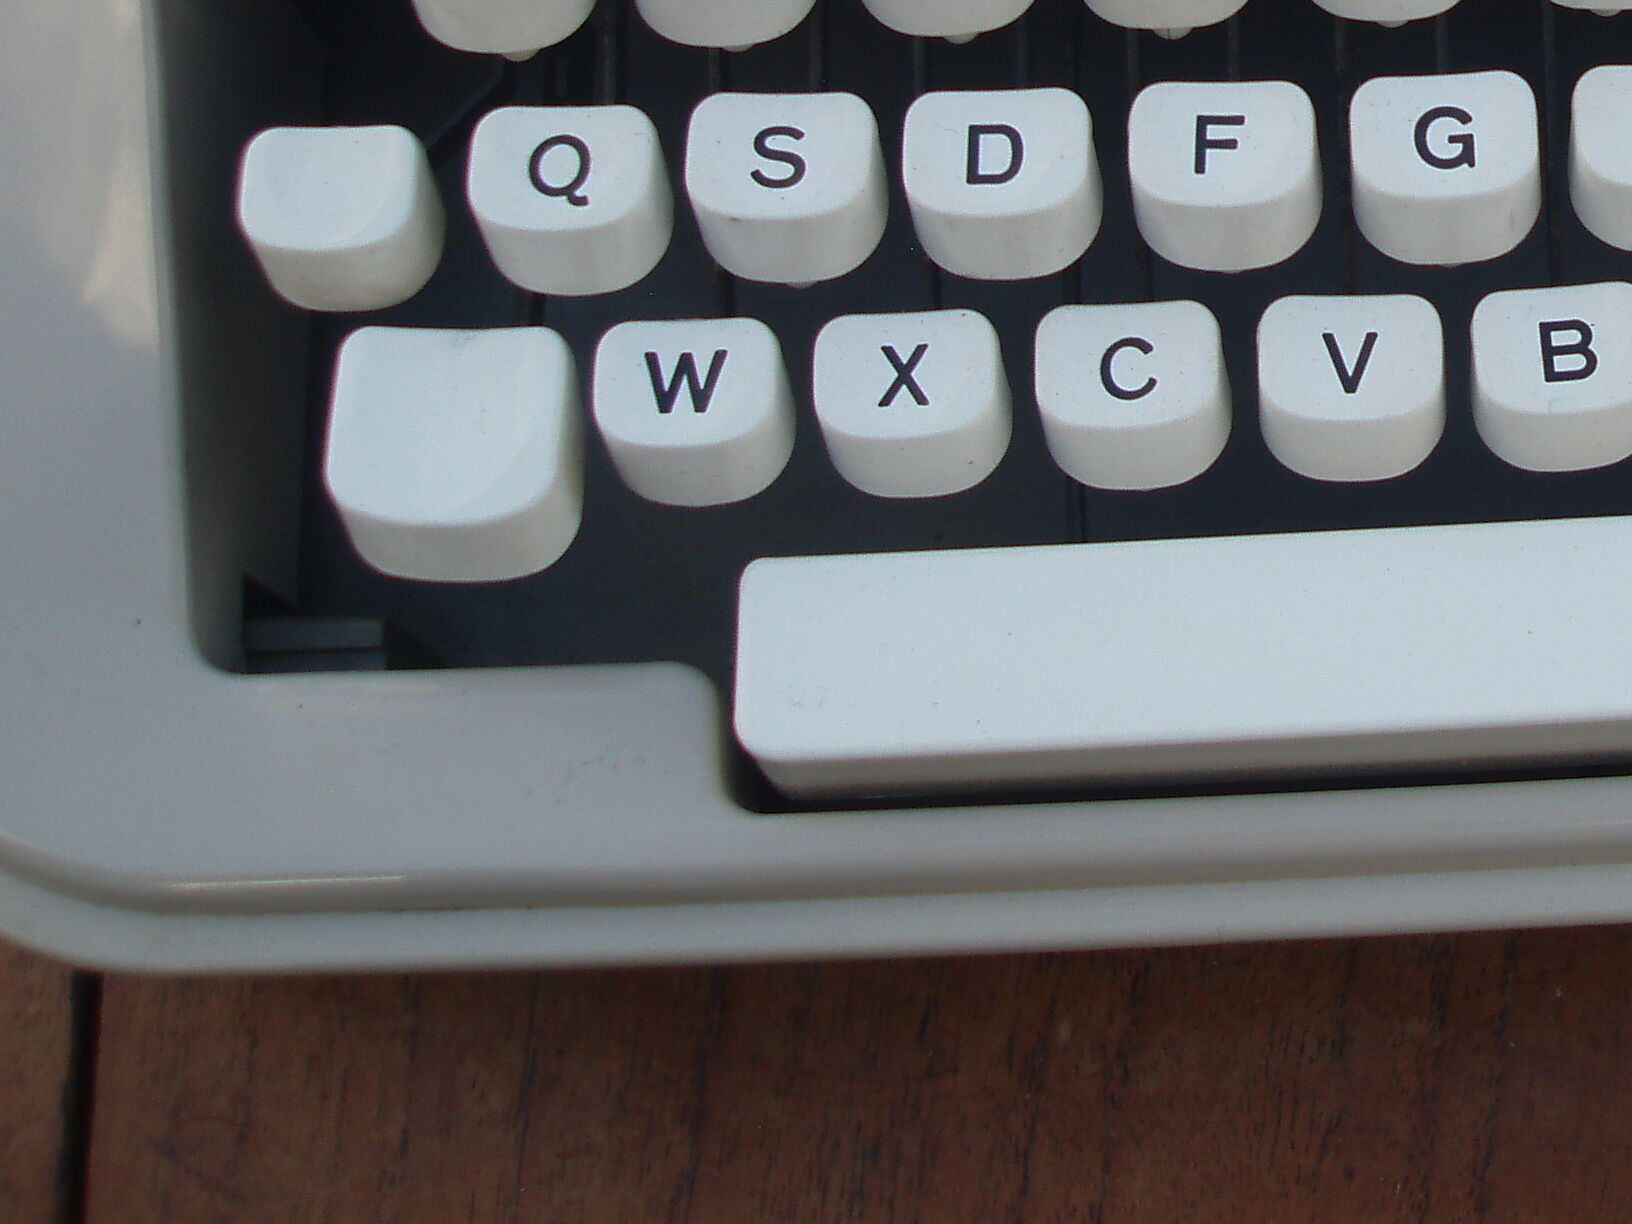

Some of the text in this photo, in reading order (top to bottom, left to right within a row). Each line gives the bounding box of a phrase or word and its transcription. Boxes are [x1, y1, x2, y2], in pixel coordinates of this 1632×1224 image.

[750, 125, 806, 189] S
[965, 124, 1024, 185] D
[1194, 114, 1245, 175] F
[1413, 106, 1476, 170] G
[528, 134, 591, 207] Q
[644, 349, 728, 414] W
[877, 343, 929, 408] X
[1099, 336, 1157, 401] C
[1321, 331, 1379, 394] V
[1538, 319, 1598, 383] B
